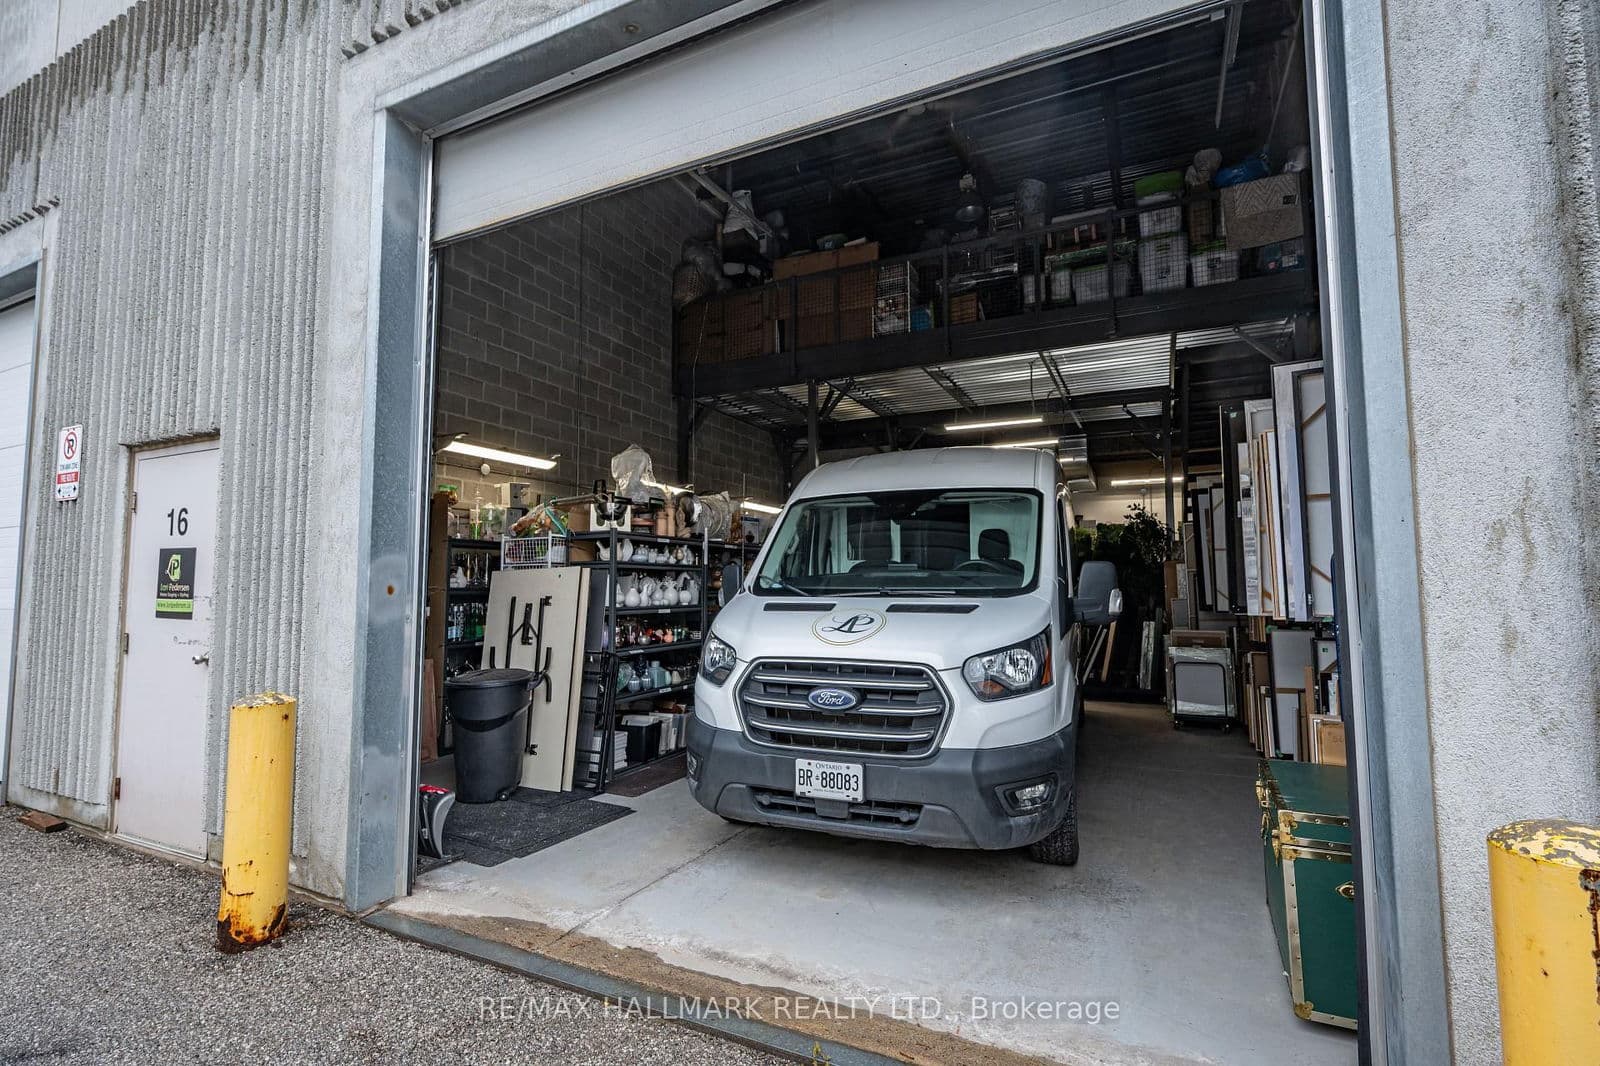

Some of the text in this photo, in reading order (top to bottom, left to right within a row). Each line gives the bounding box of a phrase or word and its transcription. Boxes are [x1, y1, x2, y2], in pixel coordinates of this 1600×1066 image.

[167, 507, 189, 537] 16
[817, 691, 845, 705] Ford
[815, 762, 843, 771] ONTARIO
[820, 771, 859, 792] 88083
